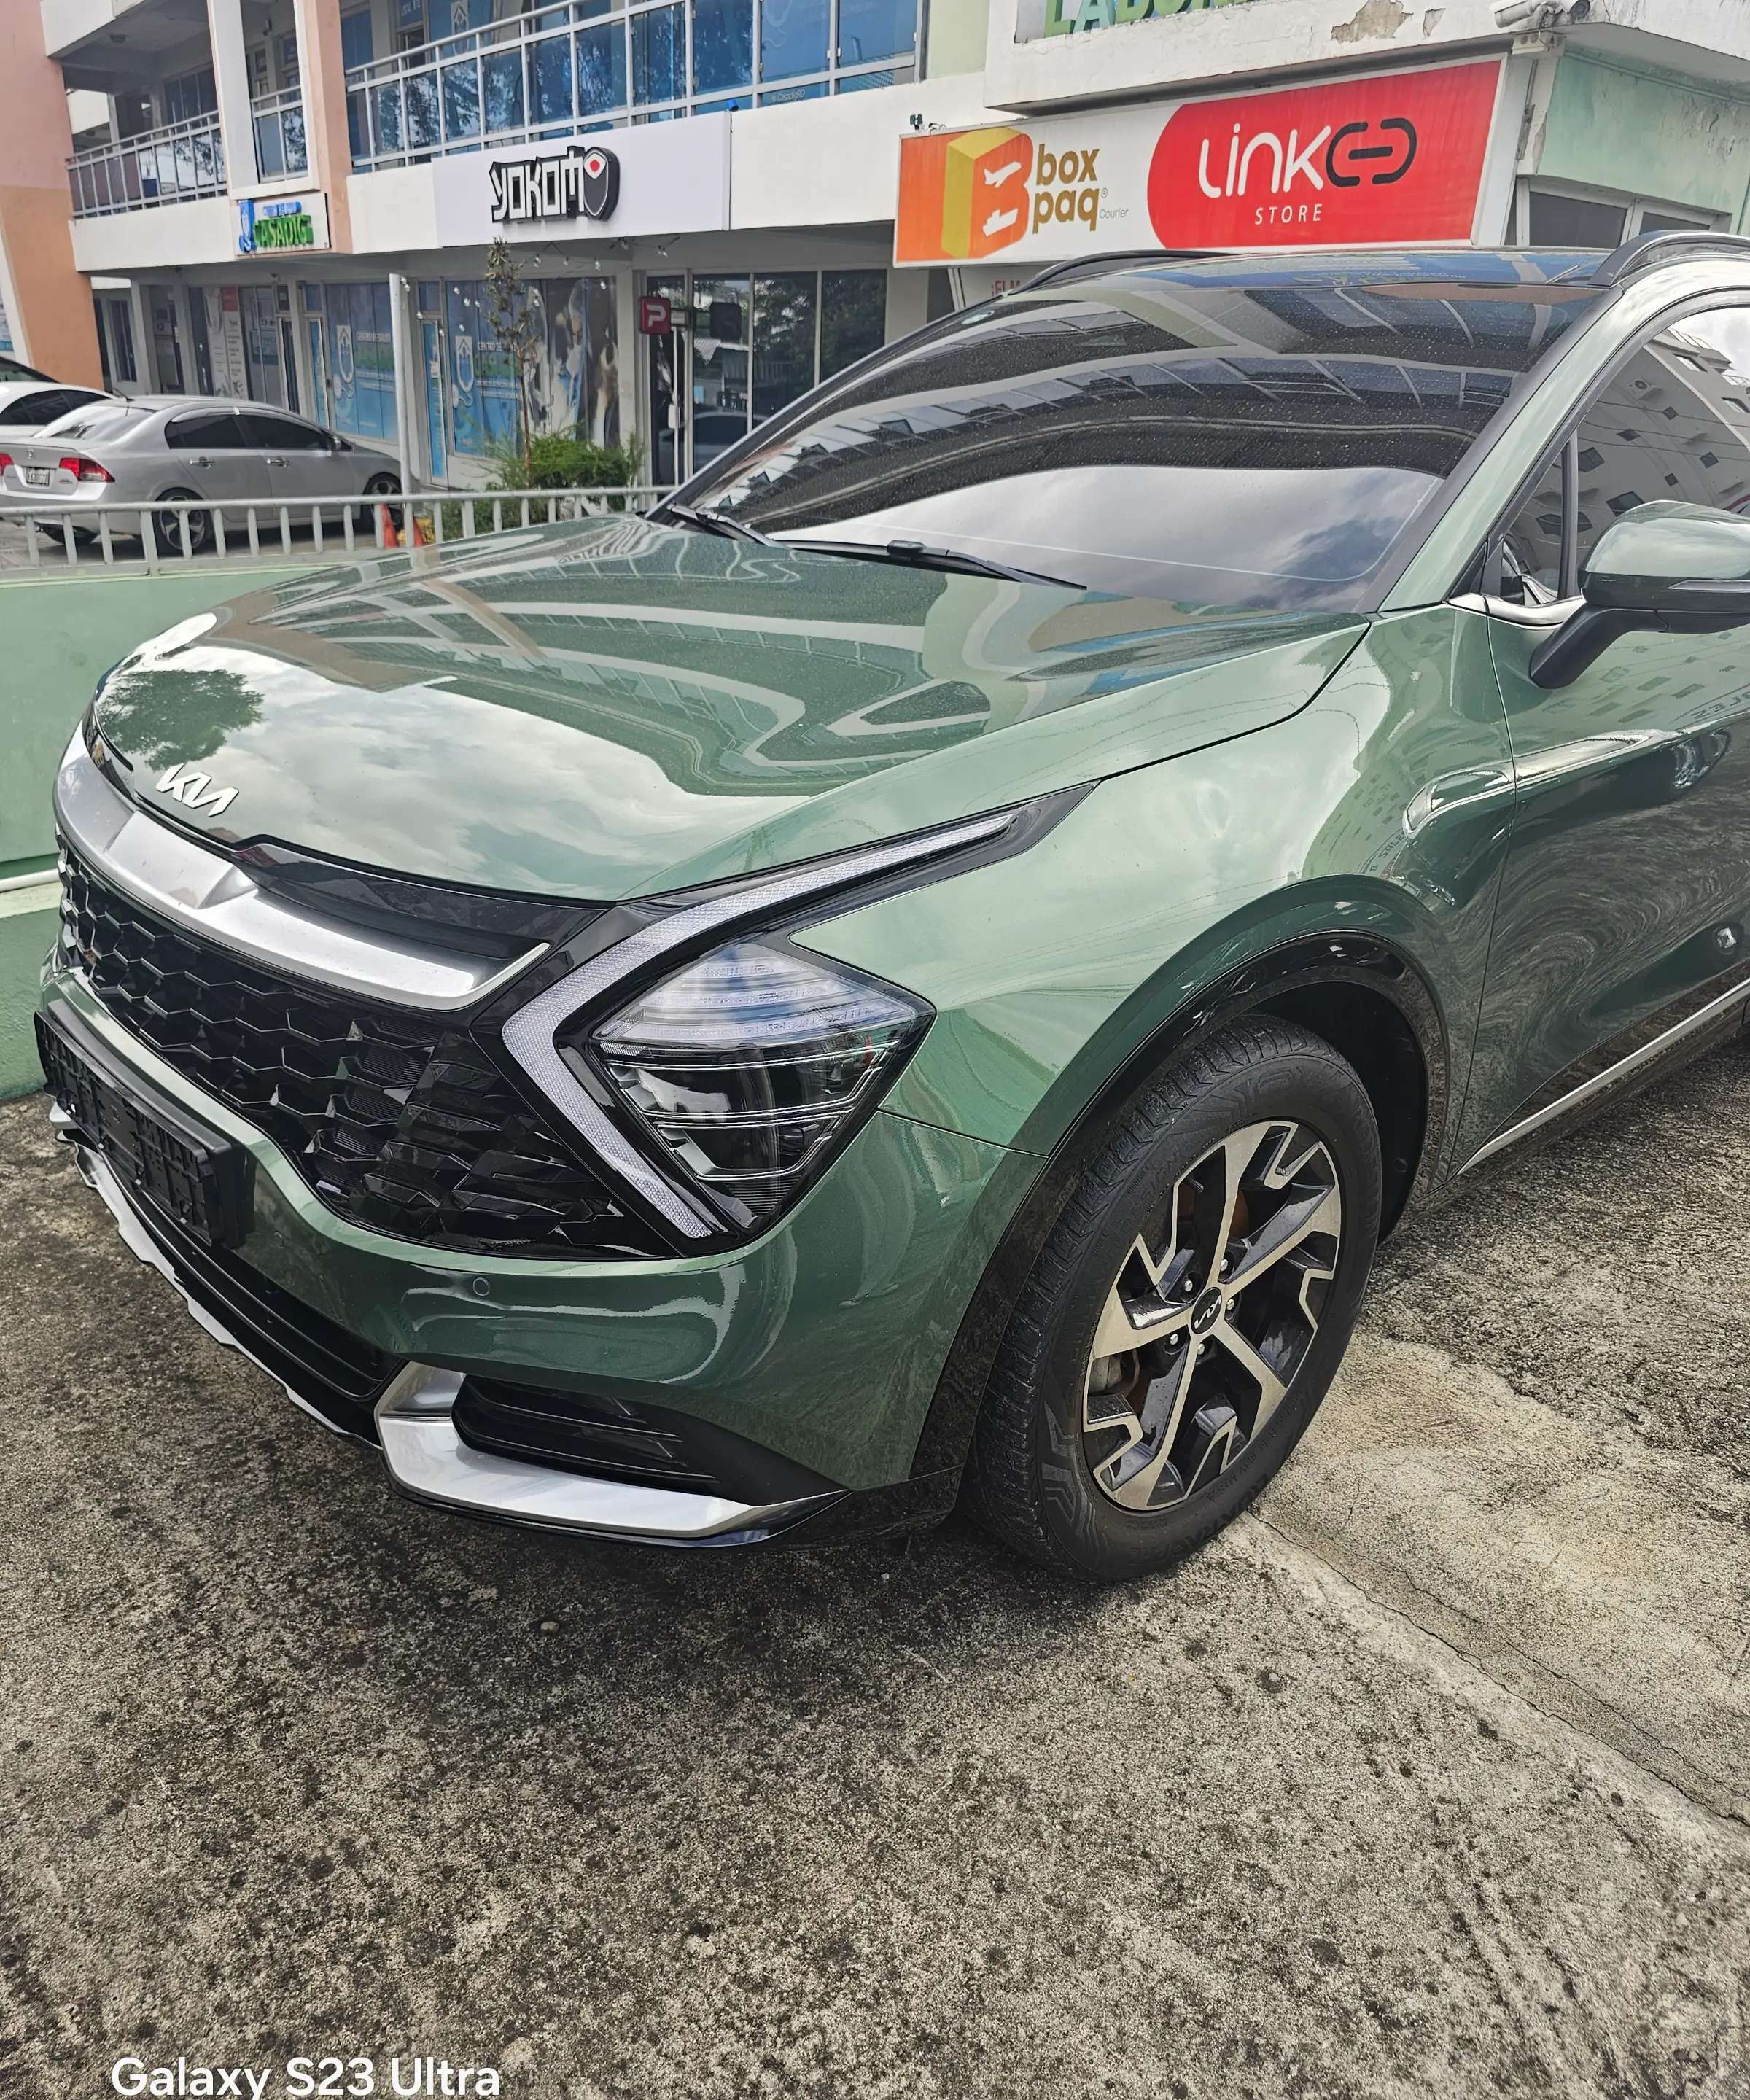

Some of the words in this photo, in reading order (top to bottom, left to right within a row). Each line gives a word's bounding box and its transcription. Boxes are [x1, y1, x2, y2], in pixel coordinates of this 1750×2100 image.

[1036, 143, 1100, 186] box
[1032, 188, 1100, 235] paq
[1099, 207, 1129, 219] Courier
[1254, 203, 1323, 225] STORE
[155, 763, 240, 817] KIA
